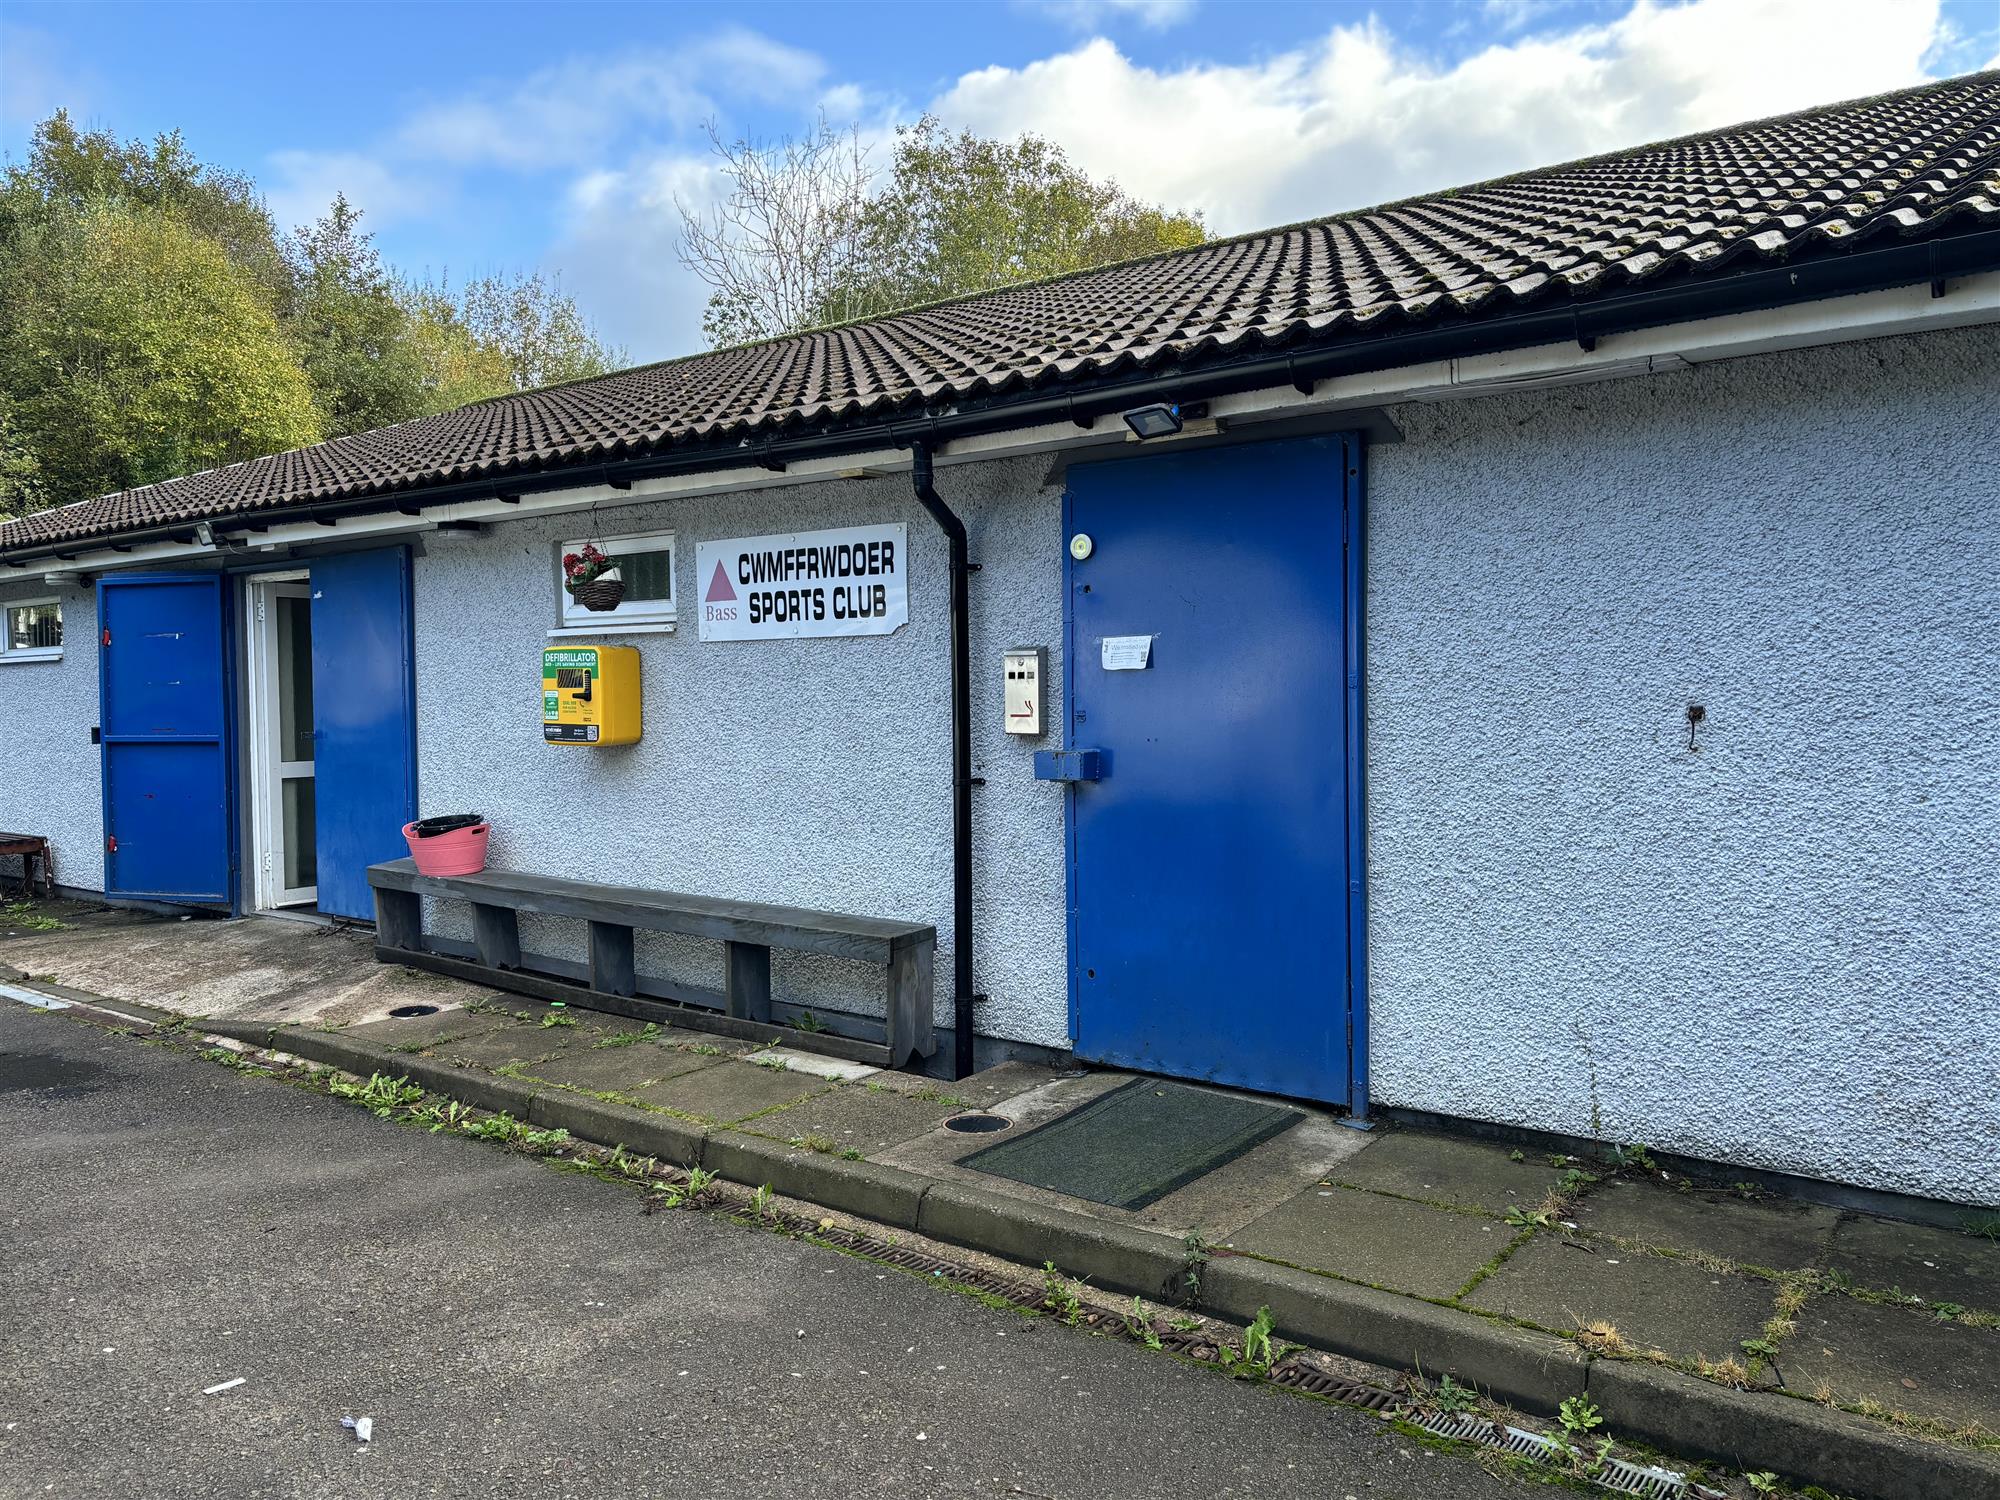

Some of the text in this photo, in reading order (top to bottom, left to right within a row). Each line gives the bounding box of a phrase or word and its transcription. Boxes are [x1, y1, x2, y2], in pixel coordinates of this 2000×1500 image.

[738, 540, 895, 585] CWMFFRWDOER
[705, 605, 737, 622] Bass
[749, 584, 887, 624] SPORTS CLUB
[545, 652, 596, 662] DEFIBRILLATOR
